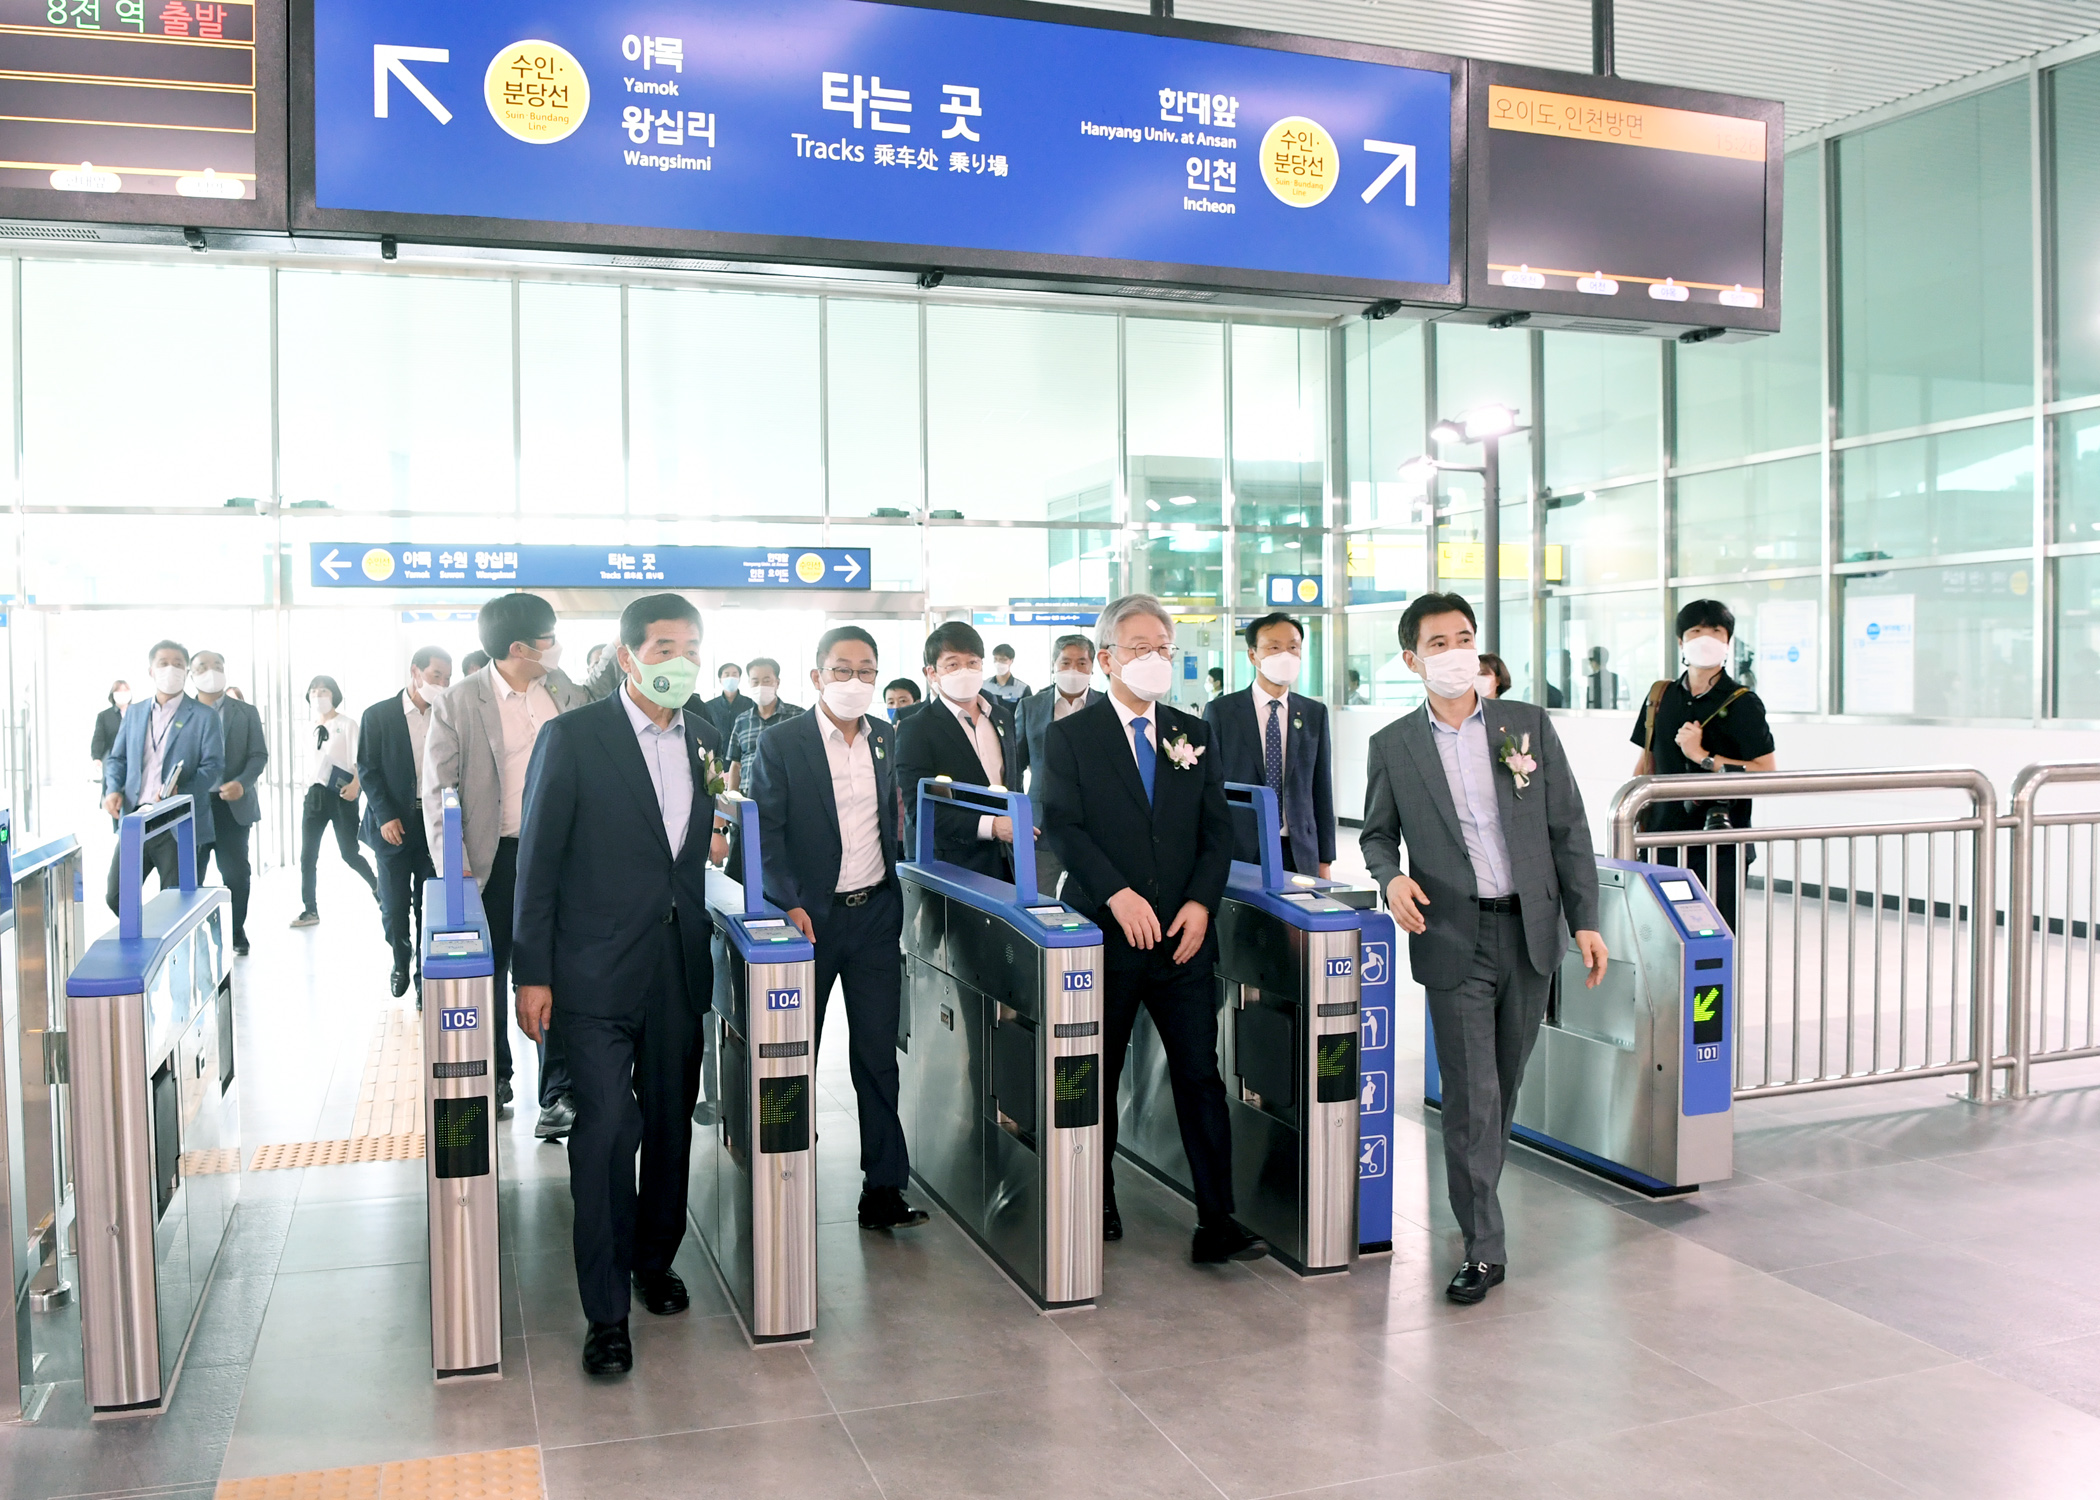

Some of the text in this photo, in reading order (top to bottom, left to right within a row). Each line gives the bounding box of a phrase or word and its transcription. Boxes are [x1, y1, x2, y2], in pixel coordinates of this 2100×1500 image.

[115, 0, 144, 33] 역
[159, 0, 228, 39] 출발
[621, 34, 684, 73] 야목
[503, 81, 569, 109] 분당선
[623, 77, 679, 96] Yamok
[822, 71, 982, 142] 타는 곳
[1158, 87, 1239, 129] 한대앞
[528, 121, 548, 132] Line
[621, 105, 716, 148] 왕십리
[1494, 98, 1643, 140] 오이도,인천방면
[1080, 120, 1237, 149] Hanyang Univ. at Ansan
[791, 132, 865, 163] Tracks
[623, 150, 712, 172] Wangsimni
[1274, 152, 1323, 178] 분당선
[1186, 156, 1237, 194] 인천
[1292, 188, 1307, 197] Line
[1184, 196, 1236, 214] Incheon
[439, 551, 468, 568] 수원
[474, 551, 518, 569] 왕십리
[608, 553, 635, 570] 타는
[1327, 960, 1351, 975] 102
[1065, 973, 1092, 989] 103
[769, 992, 799, 1008] 104
[443, 1011, 477, 1028] 105
[1698, 1047, 1717, 1060] 101
